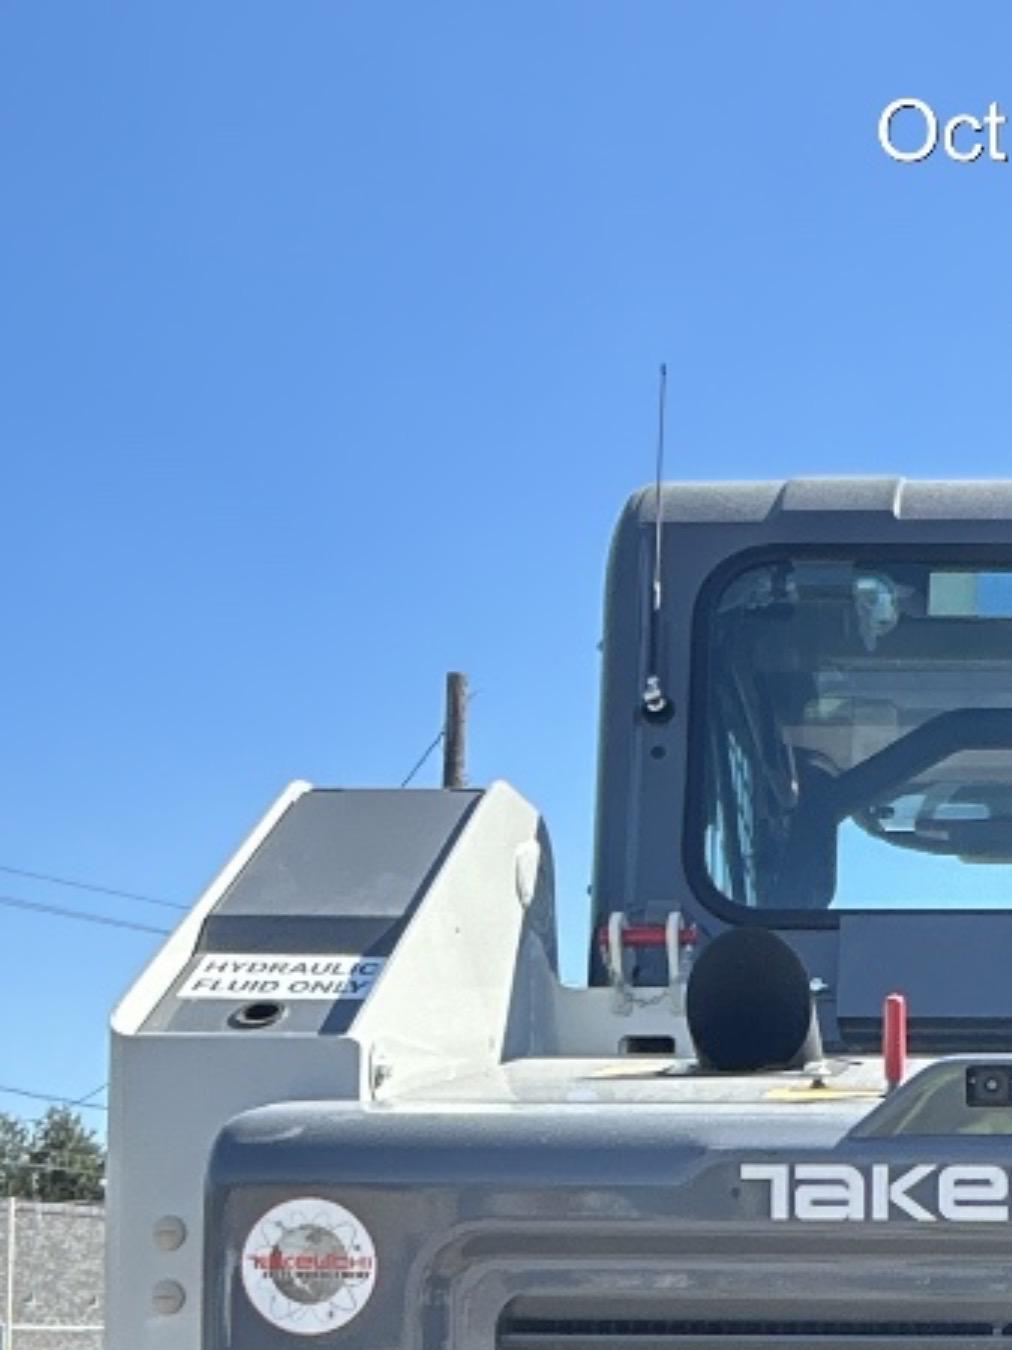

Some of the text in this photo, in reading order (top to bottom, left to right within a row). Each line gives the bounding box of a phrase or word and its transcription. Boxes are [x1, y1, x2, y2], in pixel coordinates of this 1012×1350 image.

[203, 961, 380, 976] HYDRAULIC
[191, 979, 369, 994] FLUID ONLY
